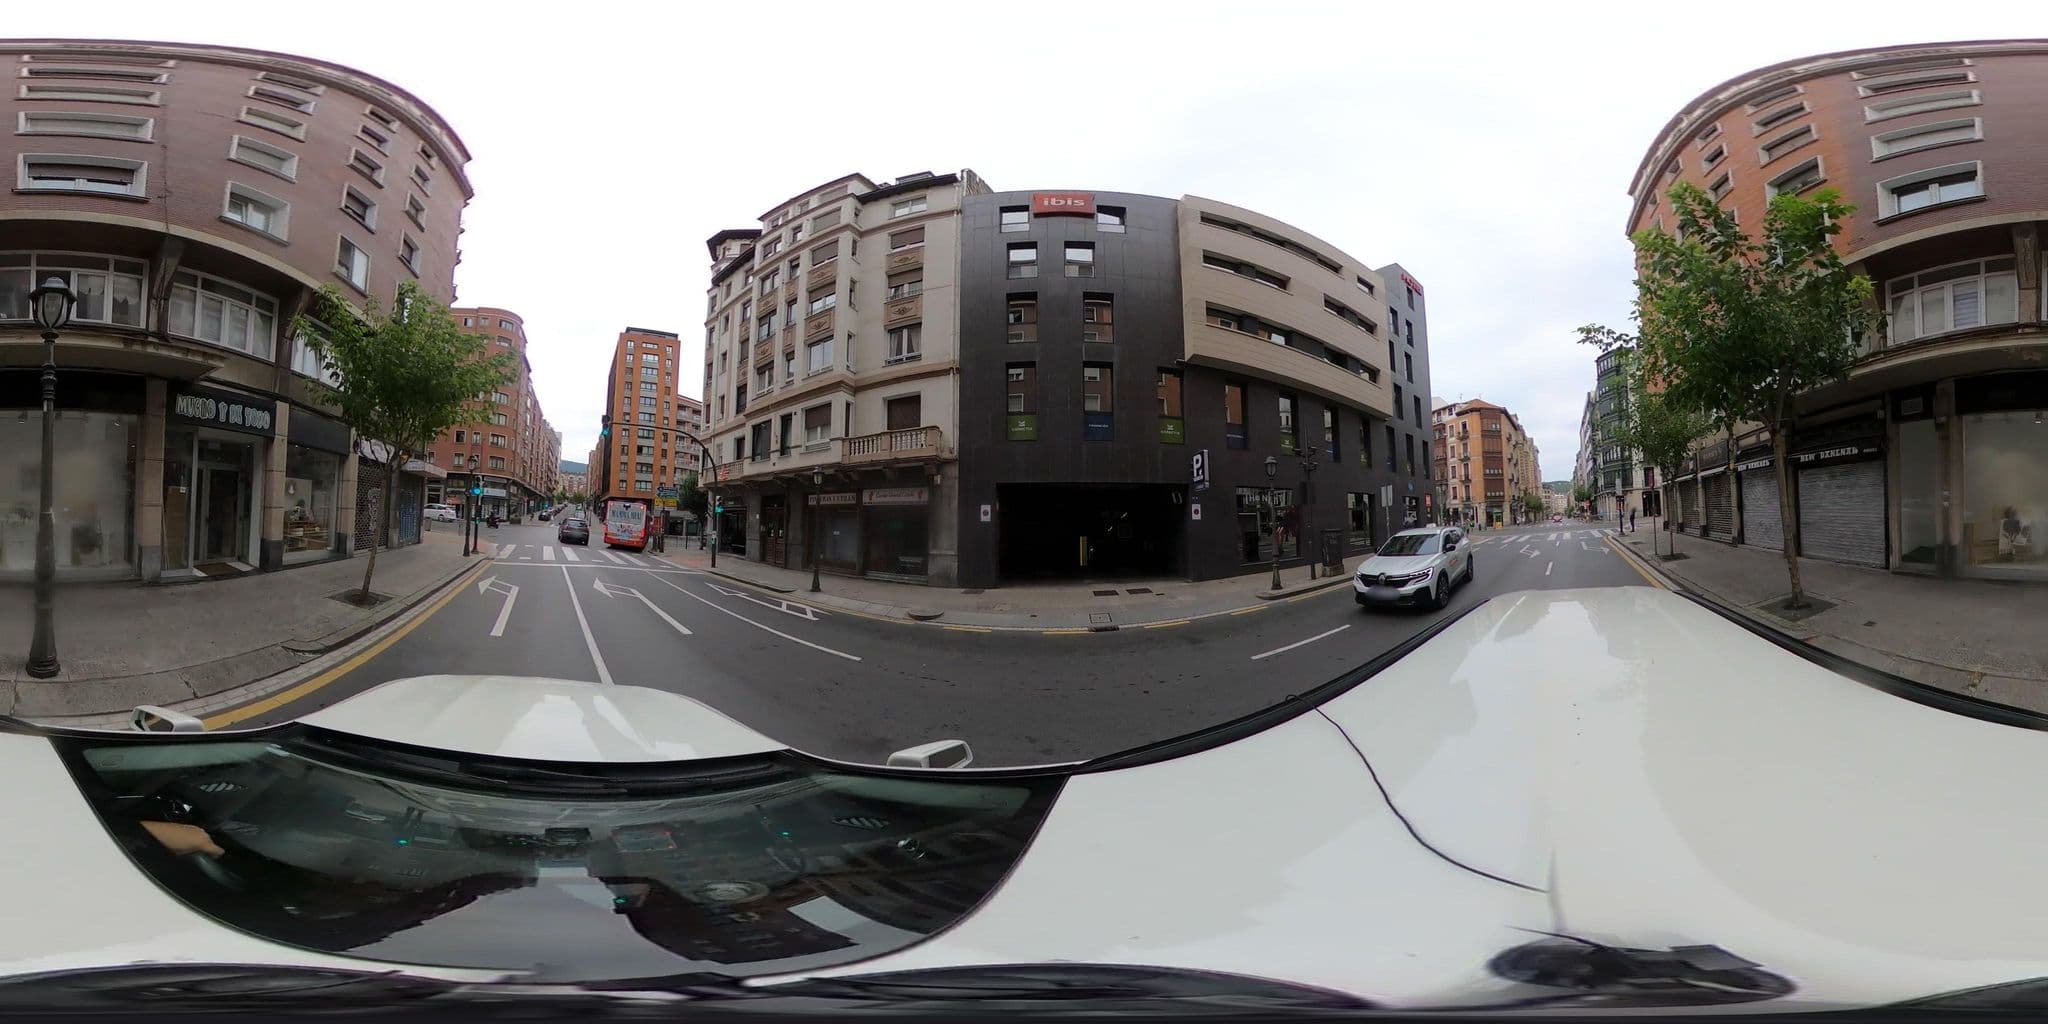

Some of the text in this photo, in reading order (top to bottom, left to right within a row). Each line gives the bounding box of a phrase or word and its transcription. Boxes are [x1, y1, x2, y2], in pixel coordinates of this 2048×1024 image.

[1043, 197, 1085, 206] ibis
[218, 401, 228, 422] Y
[229, 404, 243, 424] DE
[245, 407, 270, 429] TODO
